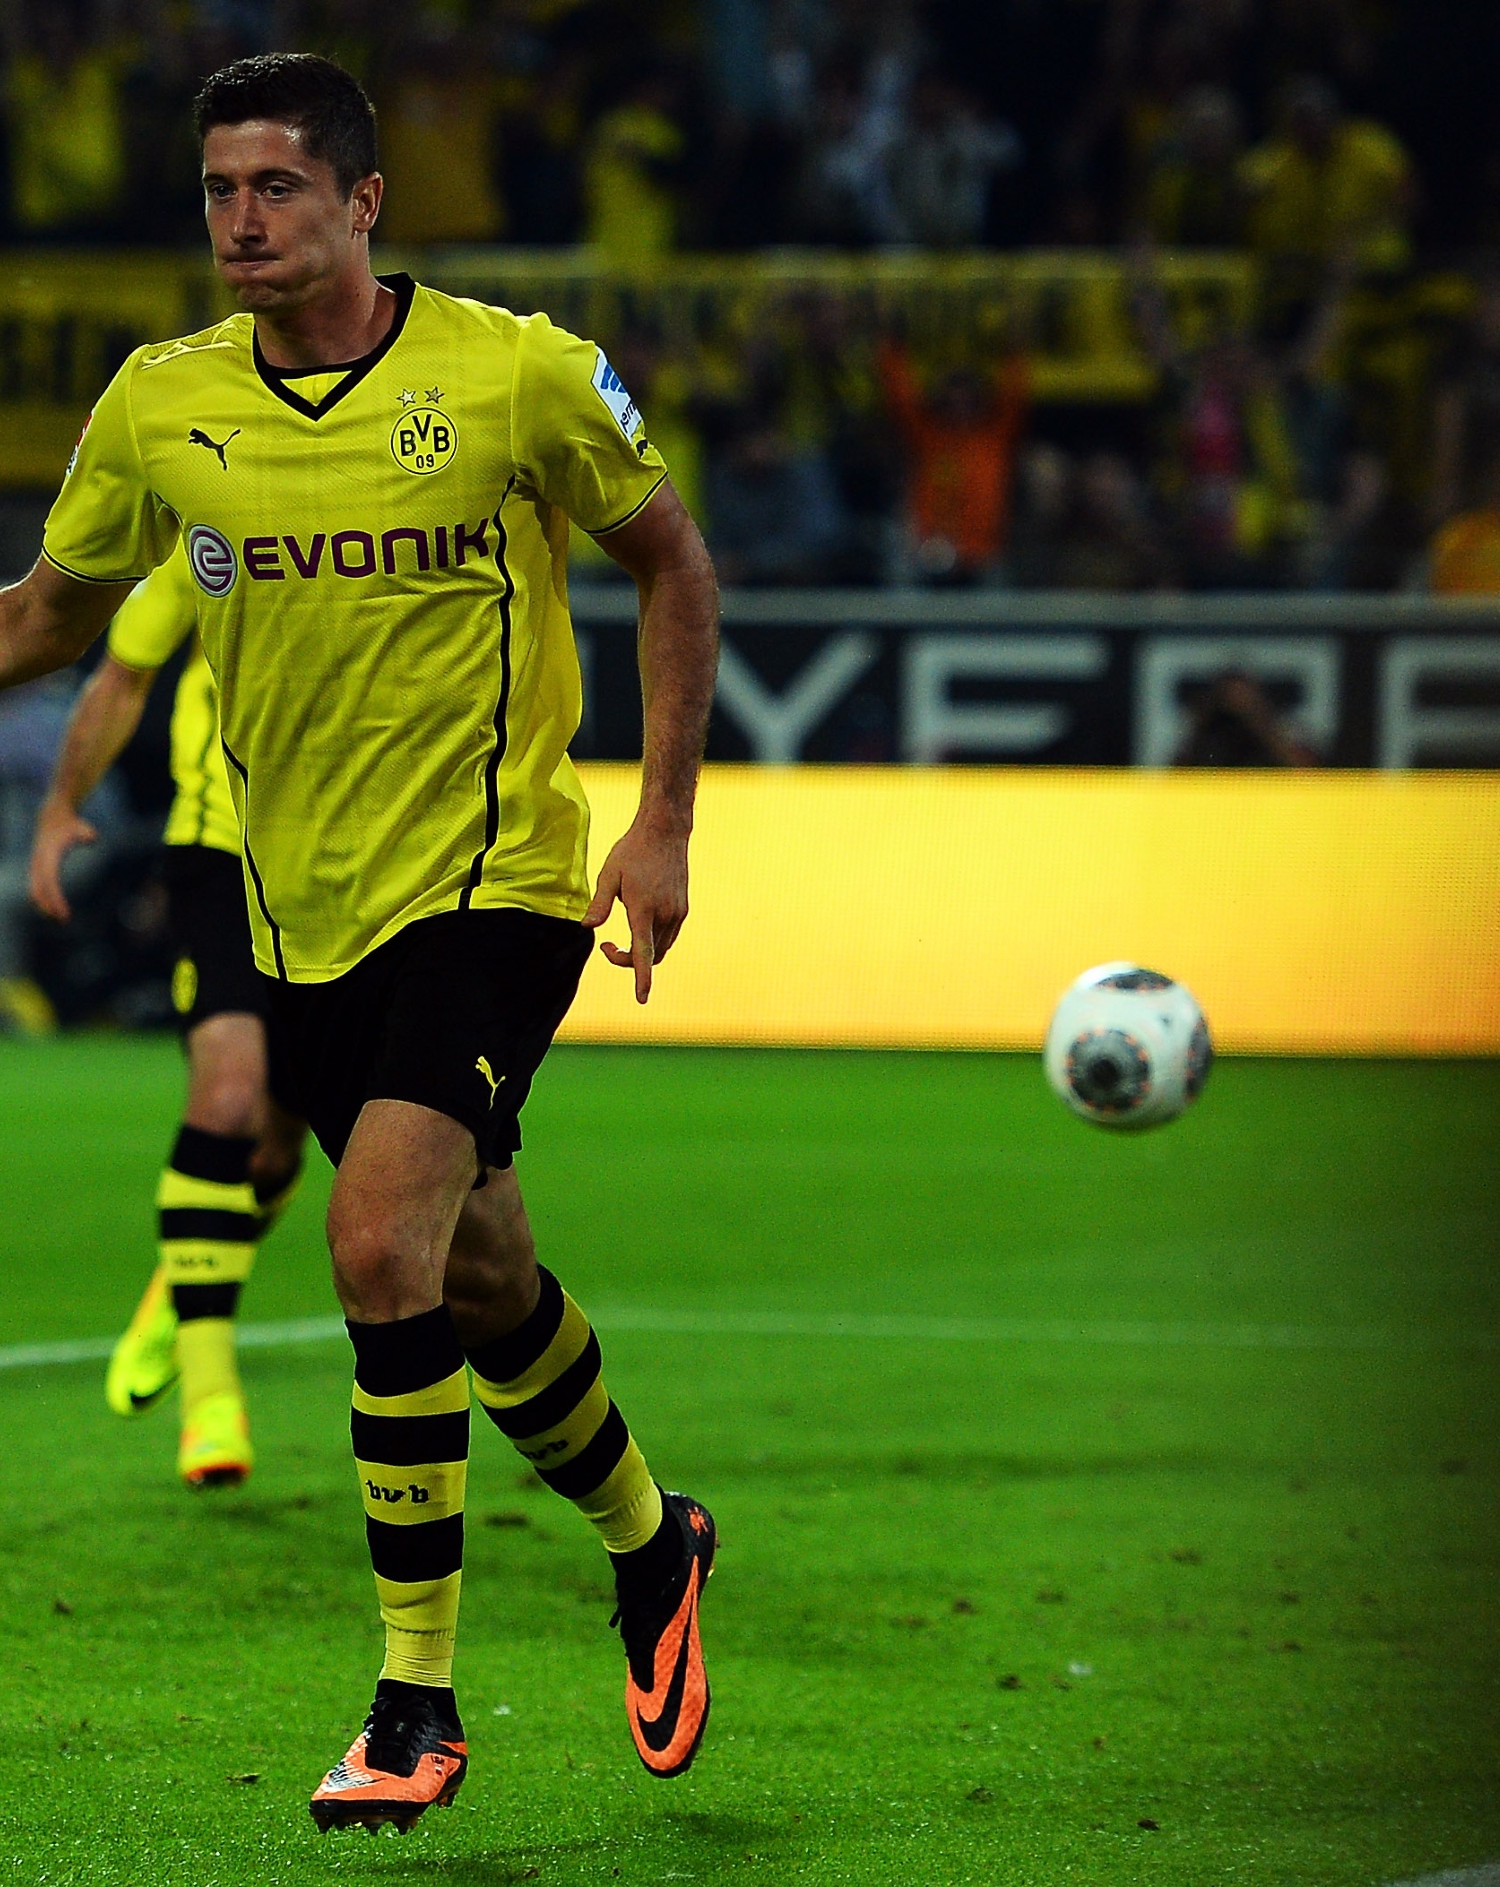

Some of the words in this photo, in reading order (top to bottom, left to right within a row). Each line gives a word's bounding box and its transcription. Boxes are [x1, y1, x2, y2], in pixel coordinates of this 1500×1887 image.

[399, 413, 451, 457] BVB
[415, 453, 435, 469] 09
[242, 517, 490, 581] EVONIK
[365, 1479, 430, 1504] bvb
